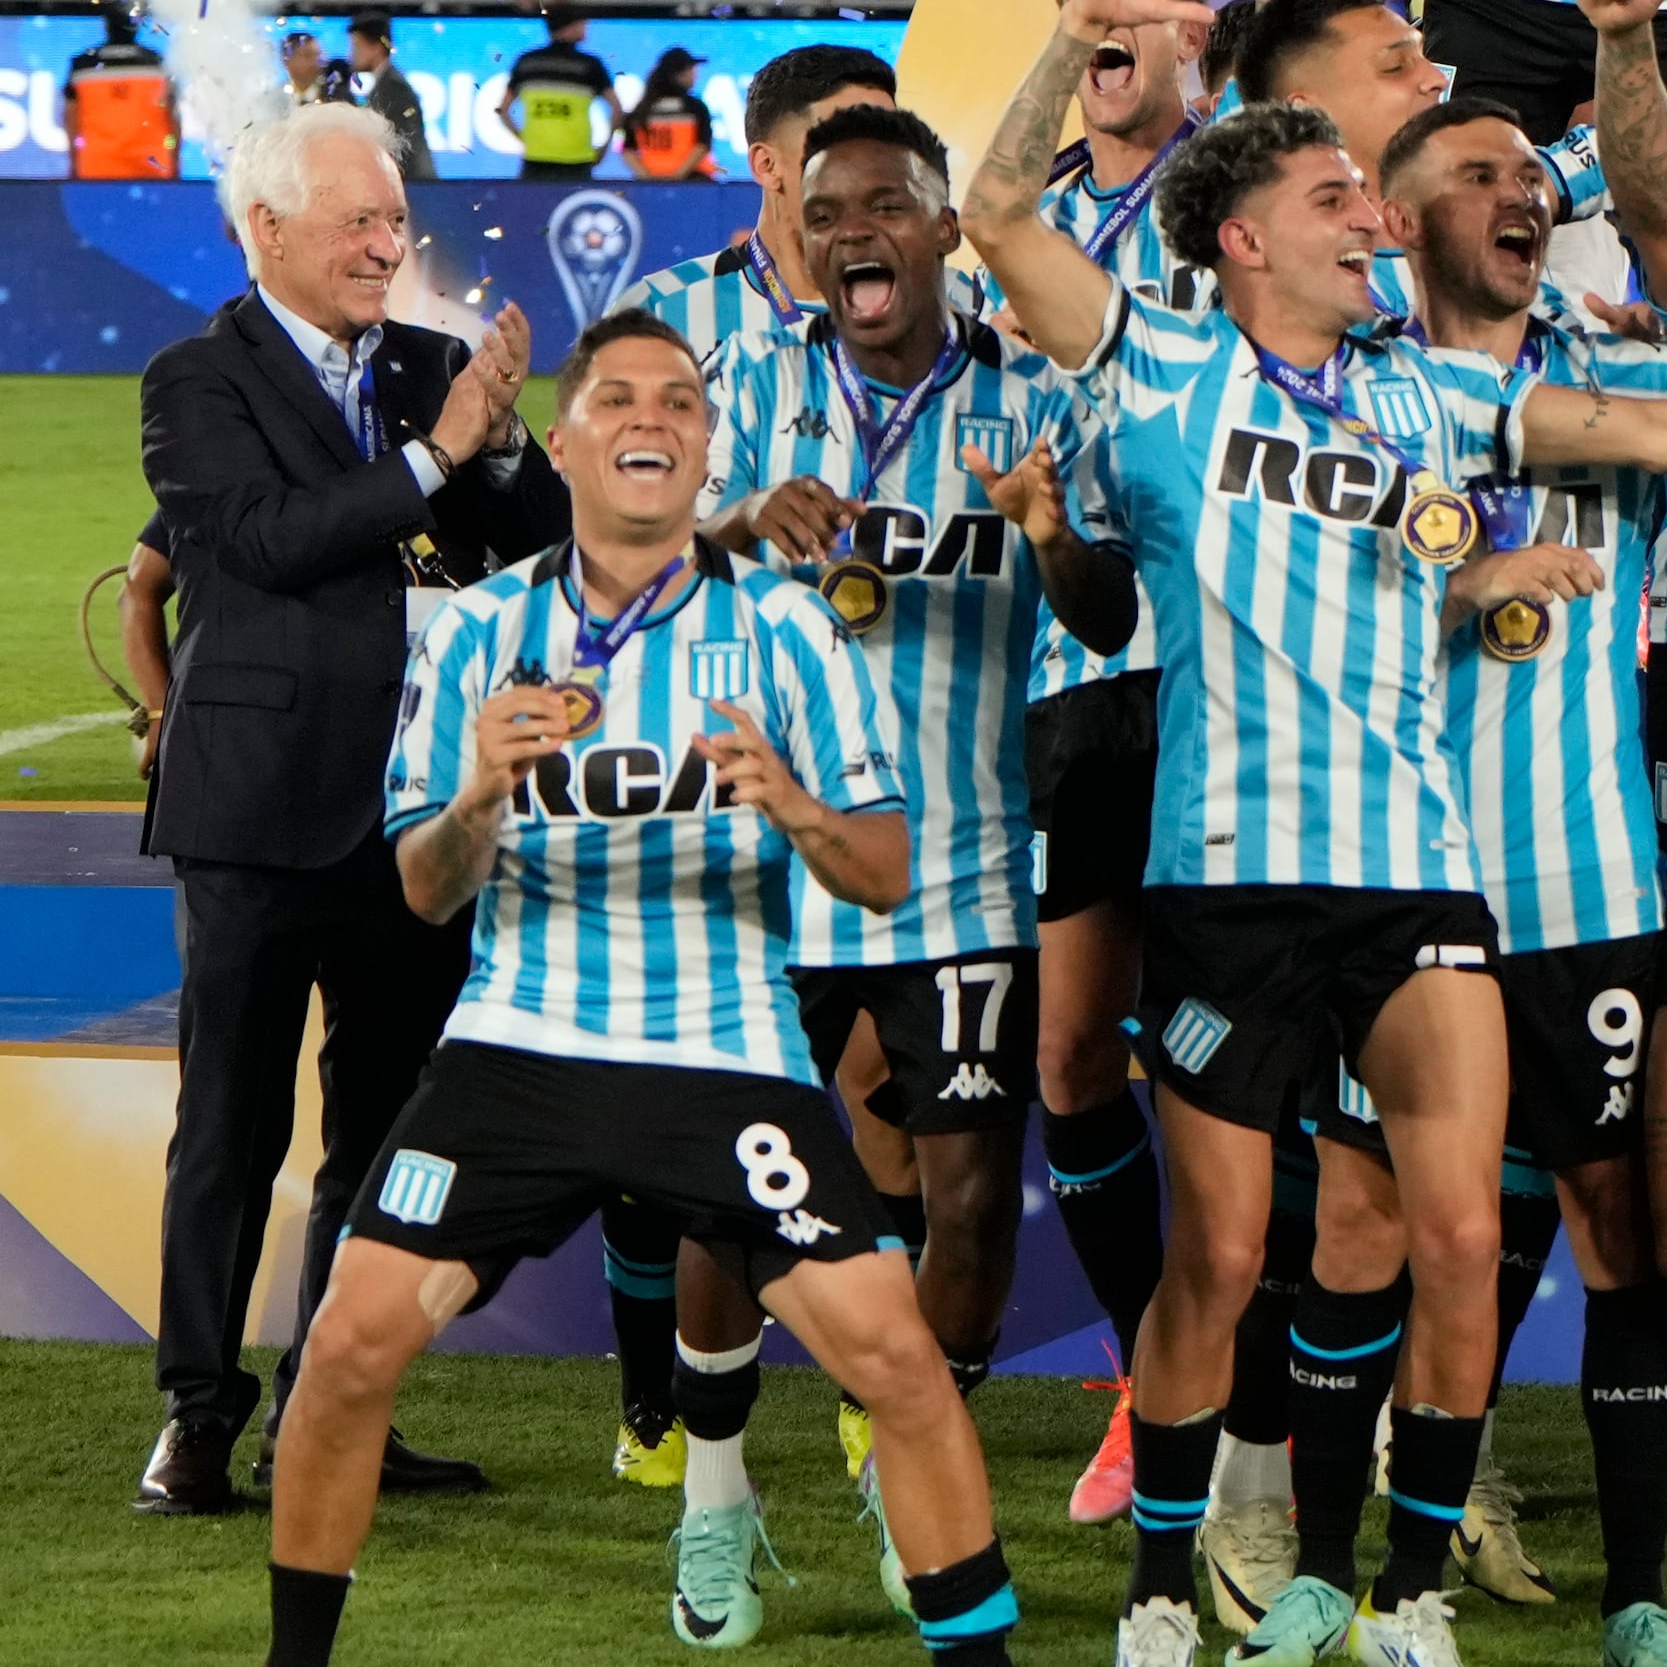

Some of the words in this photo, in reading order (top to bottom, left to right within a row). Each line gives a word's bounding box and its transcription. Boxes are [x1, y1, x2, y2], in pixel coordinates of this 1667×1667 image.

[960, 418, 1010, 432] RACING
[1369, 381, 1416, 395] RACING
[850, 502, 1008, 581] CA
[691, 642, 745, 653] RACING
[934, 961, 1015, 1054] 17
[1587, 987, 1643, 1079] 9
[735, 1122, 811, 1211] 8
